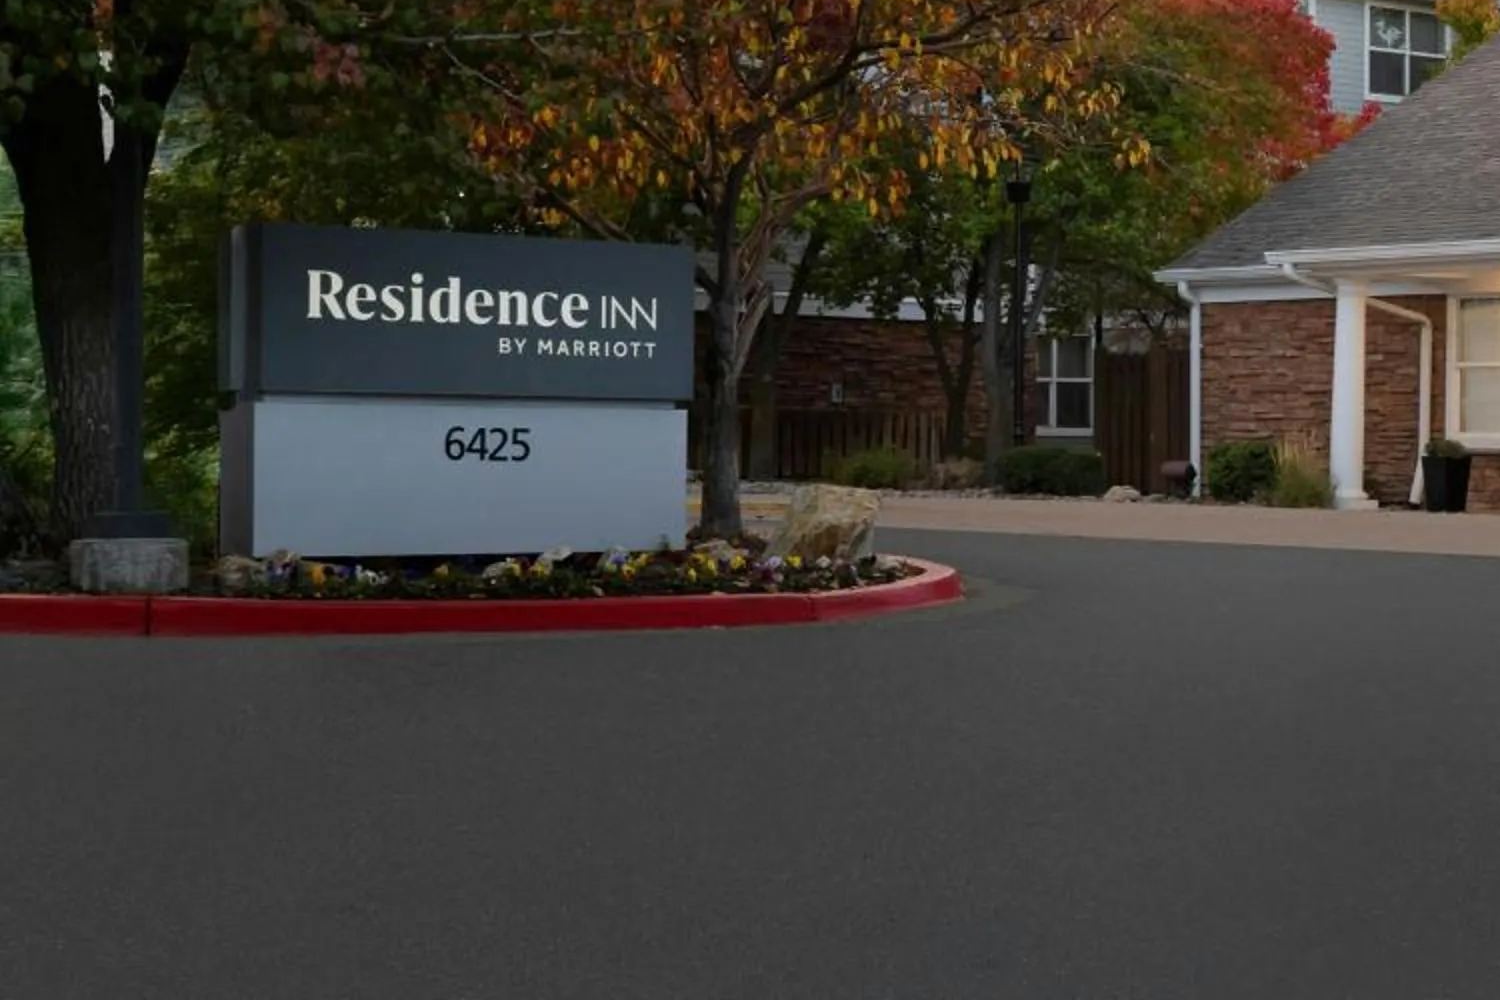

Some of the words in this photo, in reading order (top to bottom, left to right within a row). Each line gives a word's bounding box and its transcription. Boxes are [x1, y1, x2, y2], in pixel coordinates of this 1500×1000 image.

[307, 269, 590, 329] Residence
[601, 295, 657, 331] INN
[499, 337, 527, 354] BY
[537, 339, 657, 358] MARRIOTT
[444, 425, 531, 462] 6425
